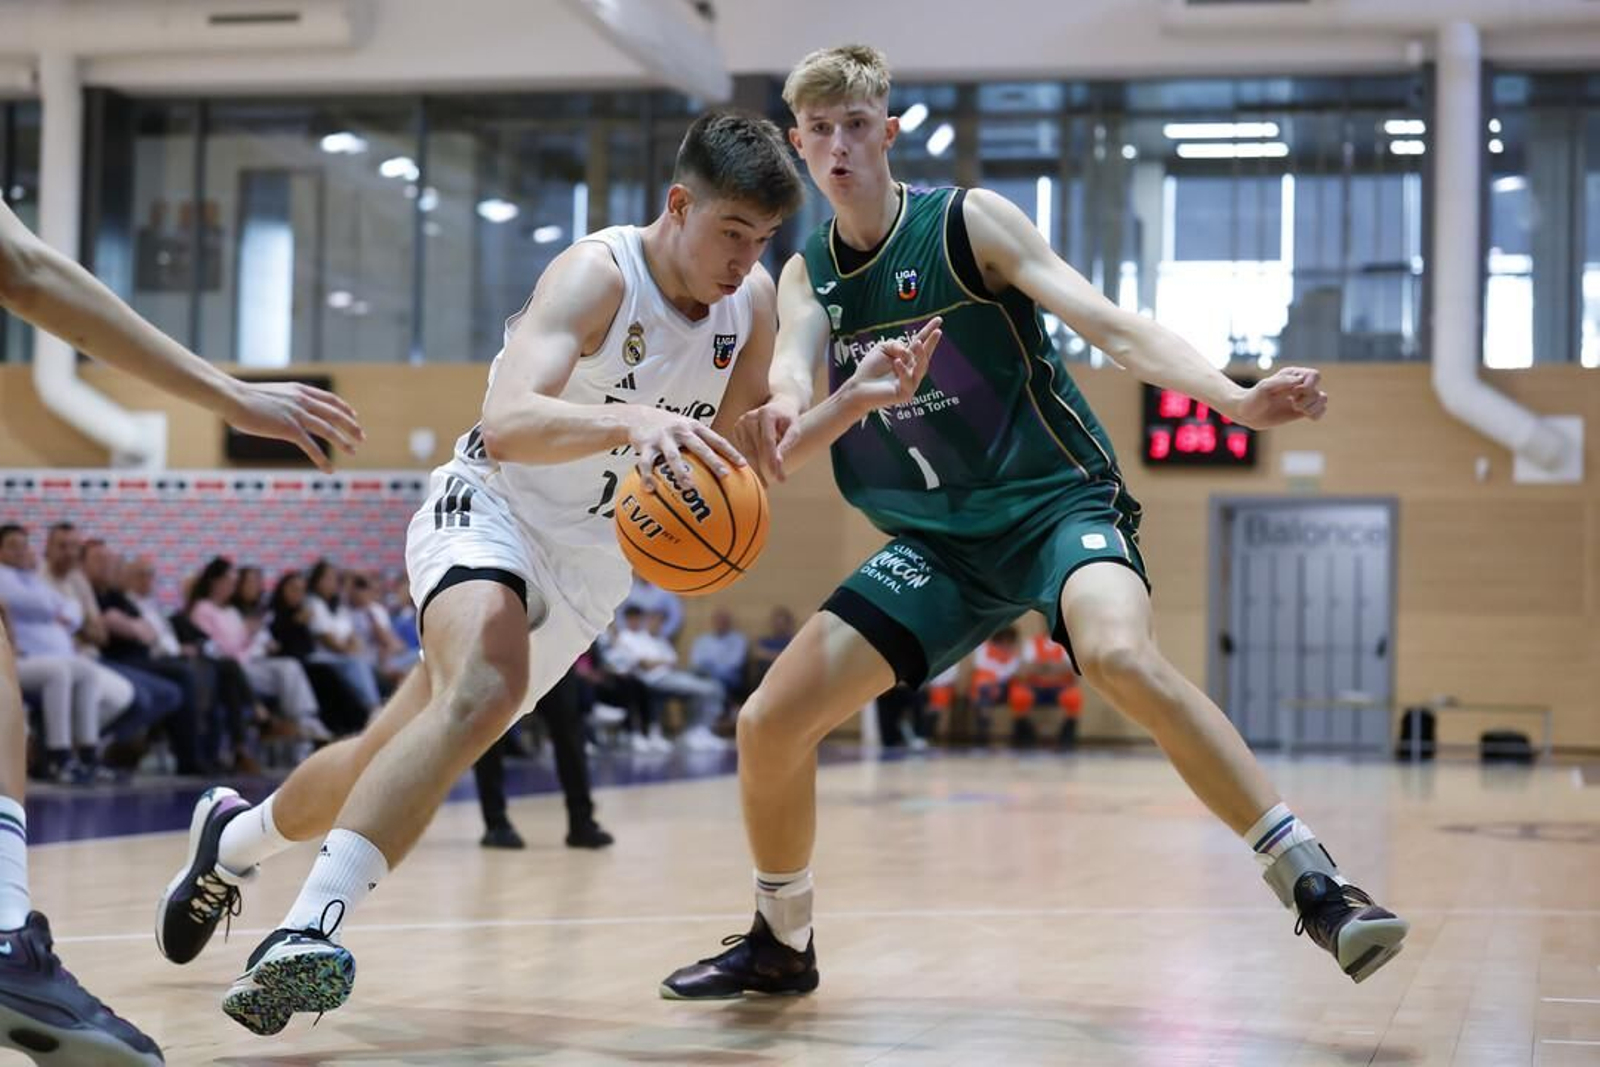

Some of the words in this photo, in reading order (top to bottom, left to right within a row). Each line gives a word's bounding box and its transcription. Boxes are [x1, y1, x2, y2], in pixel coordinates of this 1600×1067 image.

[895, 269, 917, 279] LIGA
[896, 410, 912, 420] de
[912, 406, 925, 417] la
[925, 396, 960, 413] Torre
[908, 446, 940, 490] 1
[860, 565, 902, 595] DENTAL
